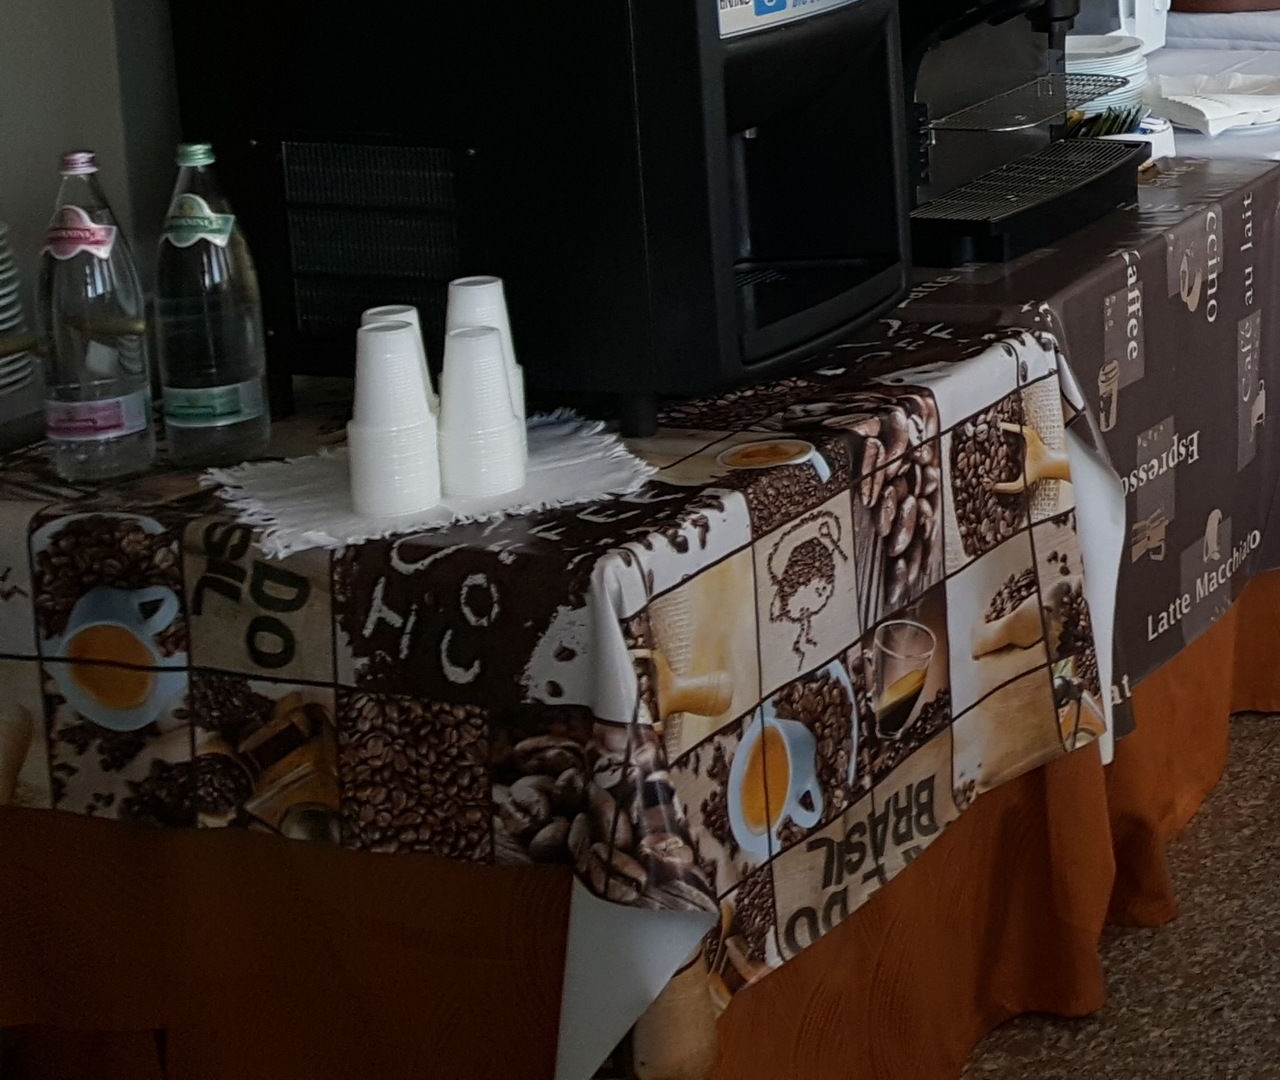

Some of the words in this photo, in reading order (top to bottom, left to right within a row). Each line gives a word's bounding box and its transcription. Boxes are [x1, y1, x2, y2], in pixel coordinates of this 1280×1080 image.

[191, 522, 251, 616] SIL
[1148, 592, 1191, 641] Latte
[1195, 529, 1262, 604] Macchiato
[806, 774, 940, 890] BRASIL
